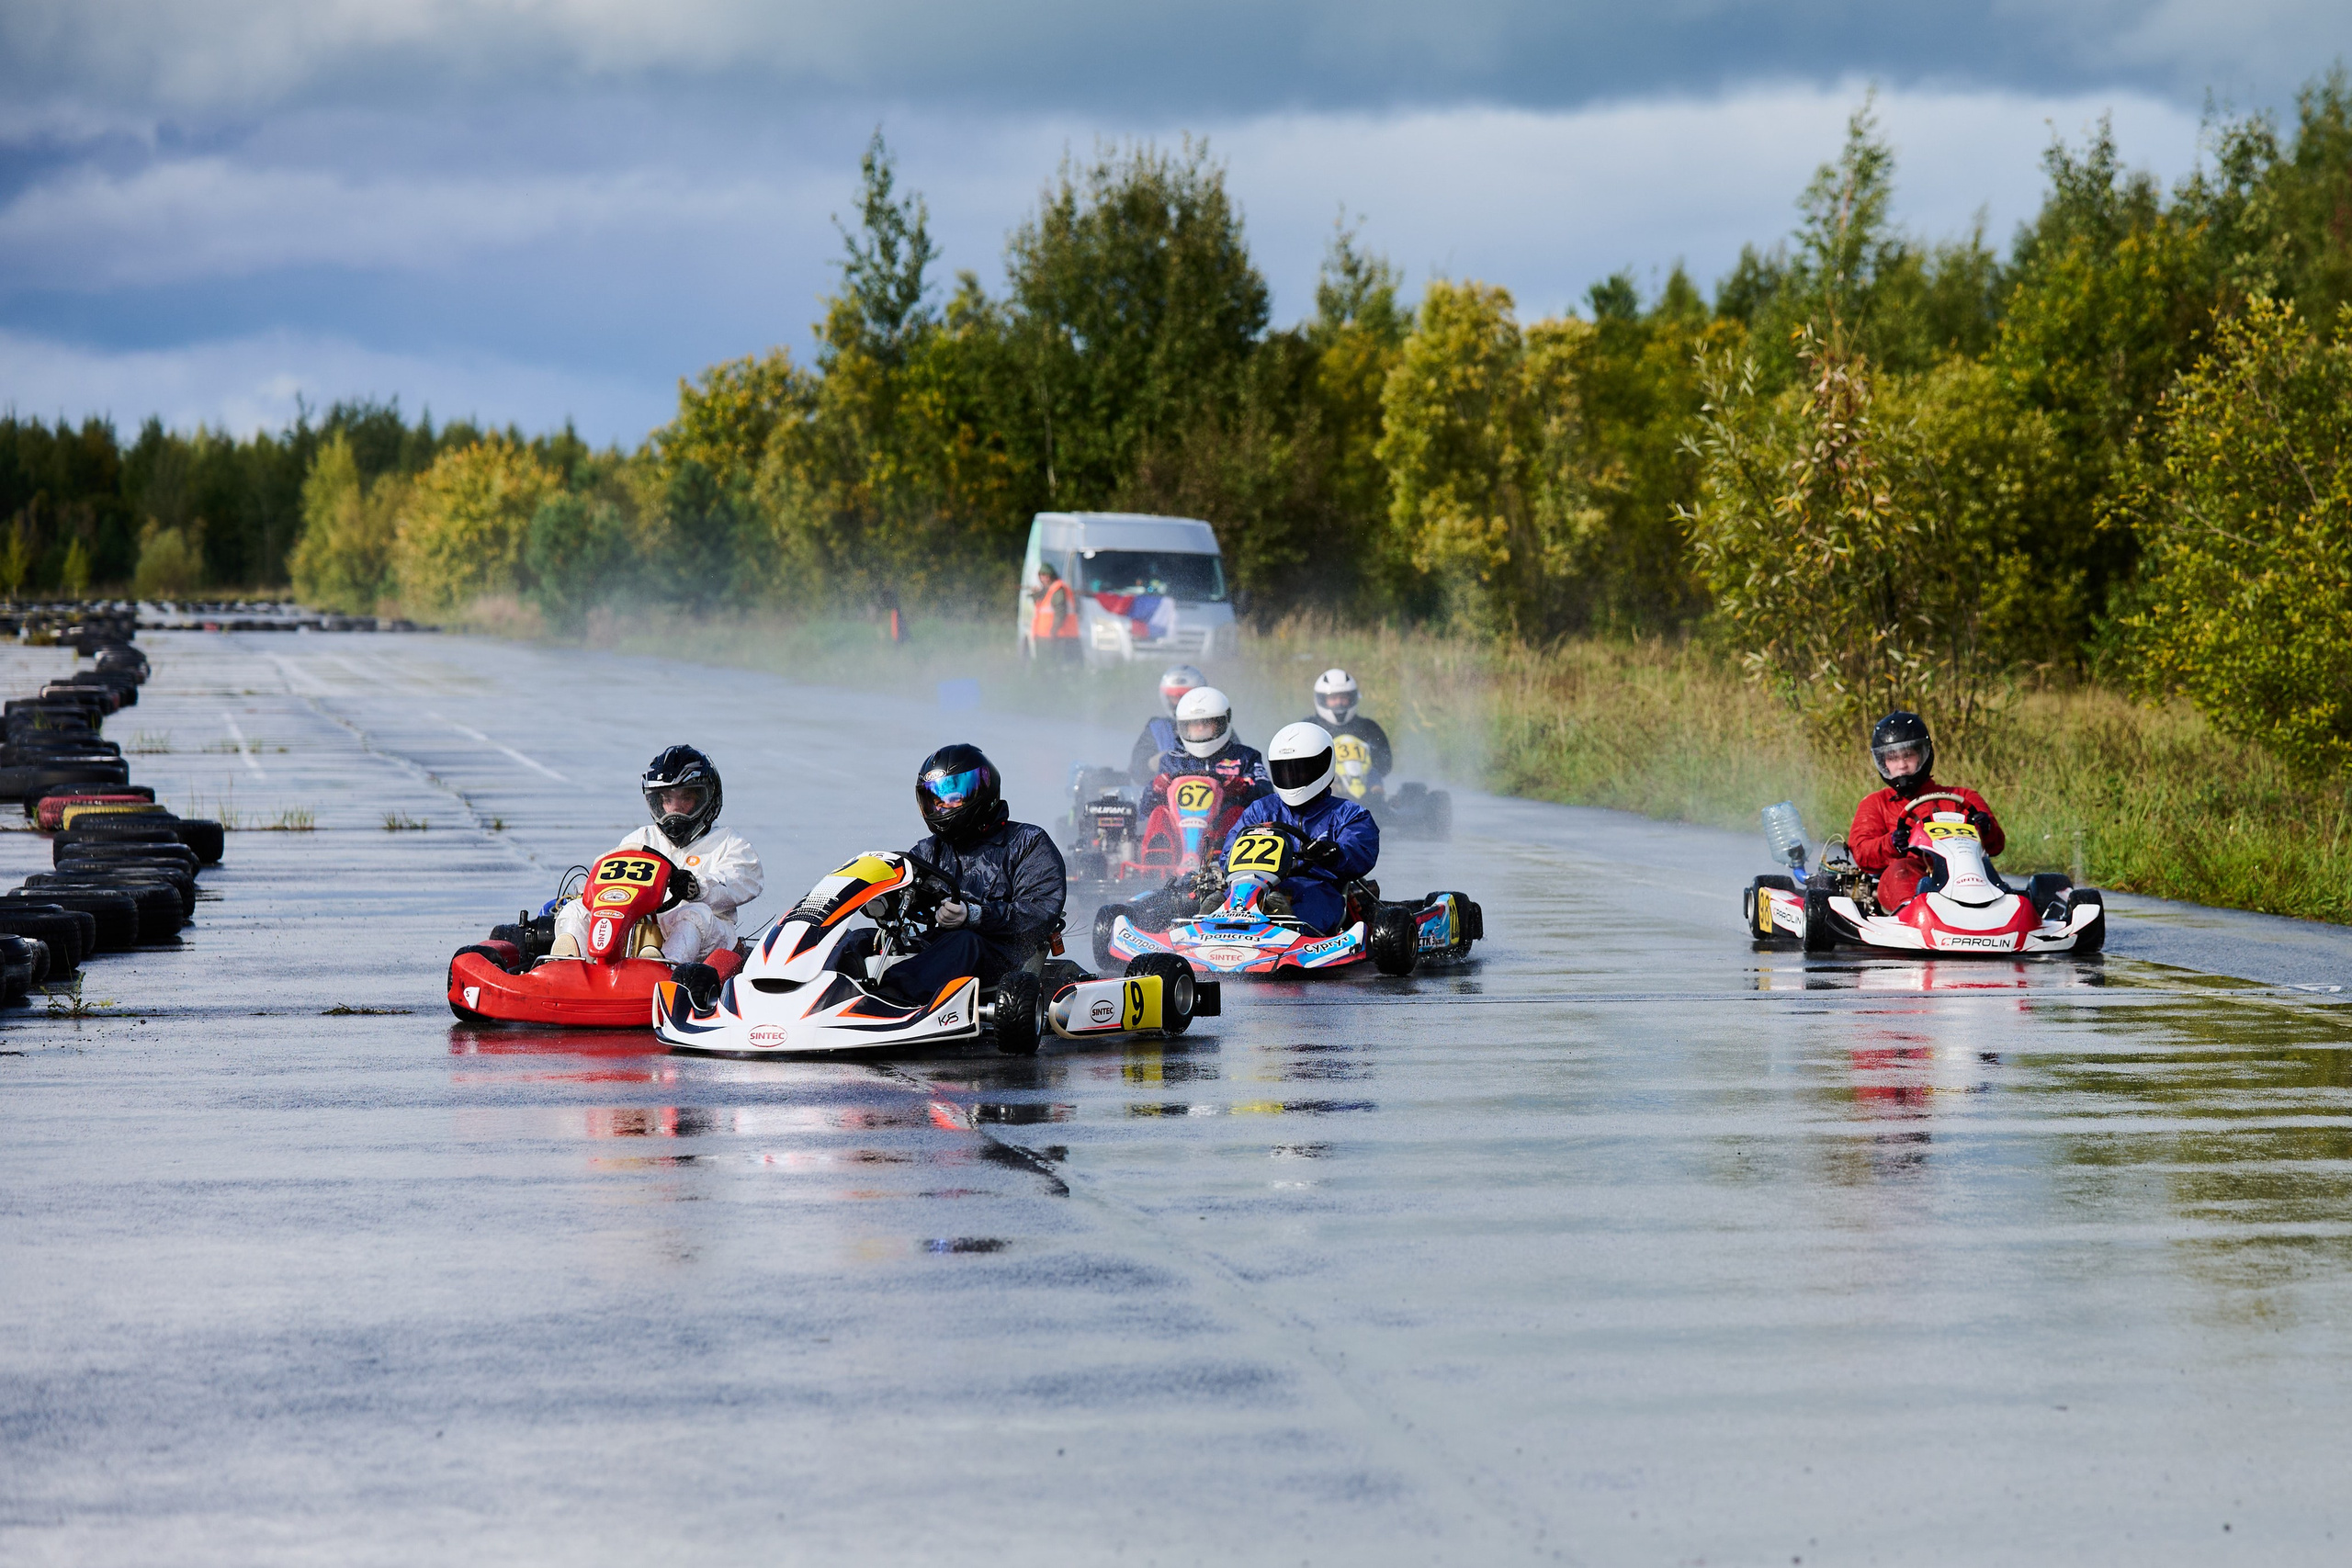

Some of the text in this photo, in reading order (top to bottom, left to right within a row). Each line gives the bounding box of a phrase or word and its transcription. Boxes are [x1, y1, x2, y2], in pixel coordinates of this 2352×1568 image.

[1339, 744, 1361, 759] 31
[1177, 784, 1213, 807] 67
[1232, 838, 1279, 866] 22
[599, 860, 655, 882] 33
[1758, 891, 1770, 927] 98
[596, 919, 608, 948] SINTEC
[1118, 928, 1163, 953] Газпром
[1199, 933, 1262, 942] Трансгаз
[1302, 934, 1351, 954] Сургут
[1951, 937, 2011, 948] PAROLIN
[1209, 953, 1243, 962] SINTEC
[1091, 1007, 1114, 1017] SINTEC
[1131, 980, 1145, 1026] 9
[750, 1032, 786, 1040] SINTEC
